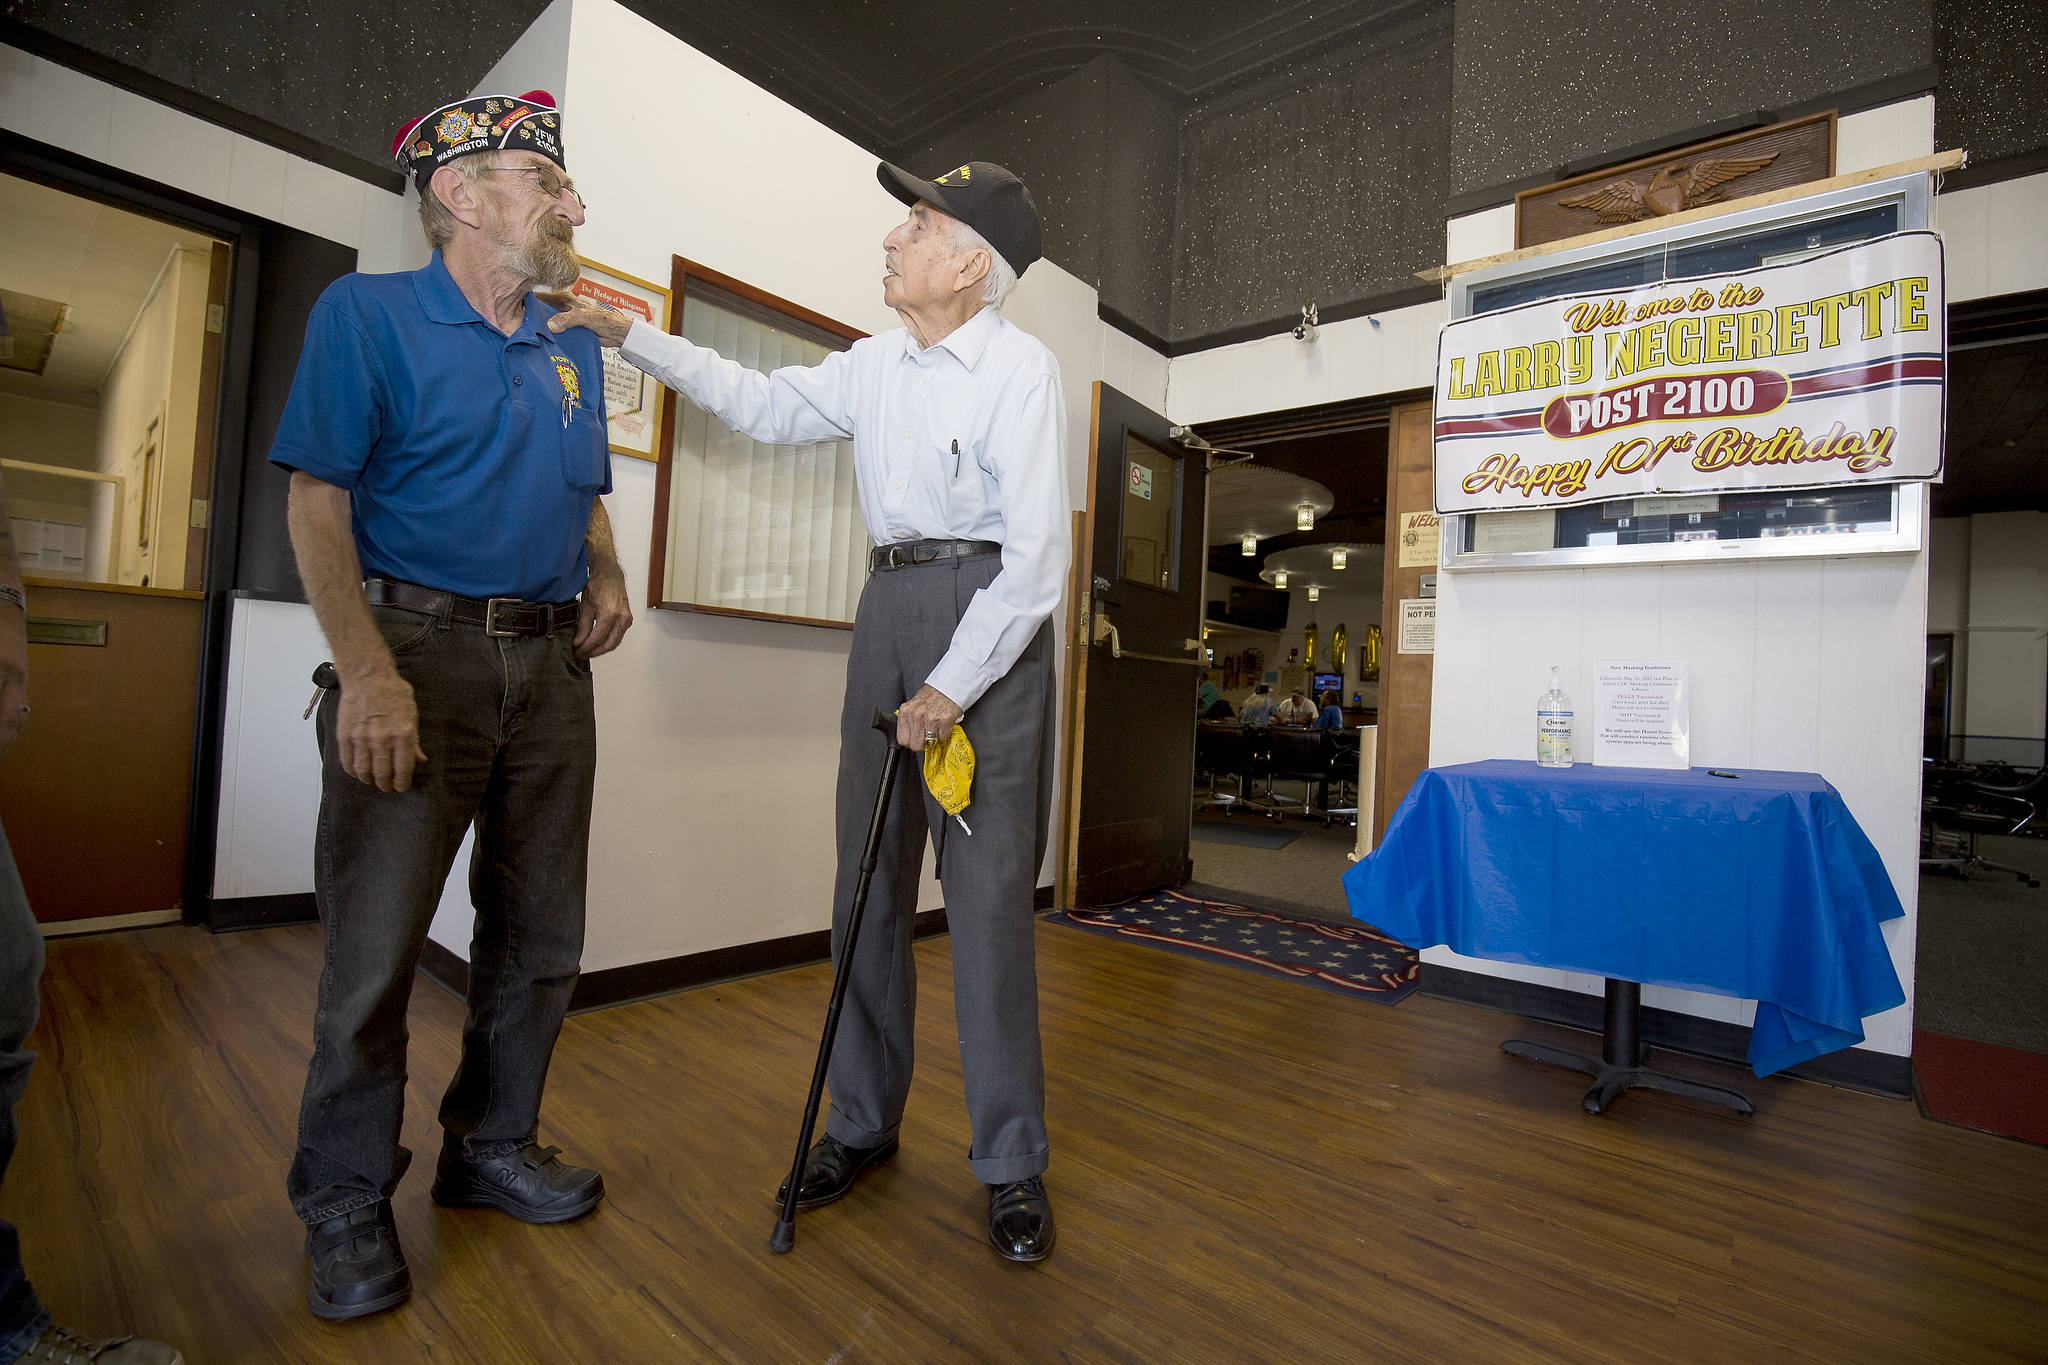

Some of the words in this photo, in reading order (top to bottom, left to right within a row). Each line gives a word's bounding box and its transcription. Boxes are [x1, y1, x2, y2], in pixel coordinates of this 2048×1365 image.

[436, 138, 489, 163] WASHINGTON
[534, 128, 555, 145] VFW
[535, 137, 559, 157] 2100
[581, 283, 592, 294] The
[593, 286, 613, 302] Pledge
[1563, 298, 1687, 334] Welcome
[1687, 287, 1715, 312] to
[1718, 282, 1764, 308] the
[1448, 334, 1593, 400] LARRY
[1605, 276, 1929, 379] NEGERETTE
[1569, 383, 1655, 433] POST
[1663, 376, 1755, 415] 2100
[1462, 453, 1592, 498] Happy
[1595, 431, 1698, 479] 101st
[1692, 420, 1898, 474] Birthday
